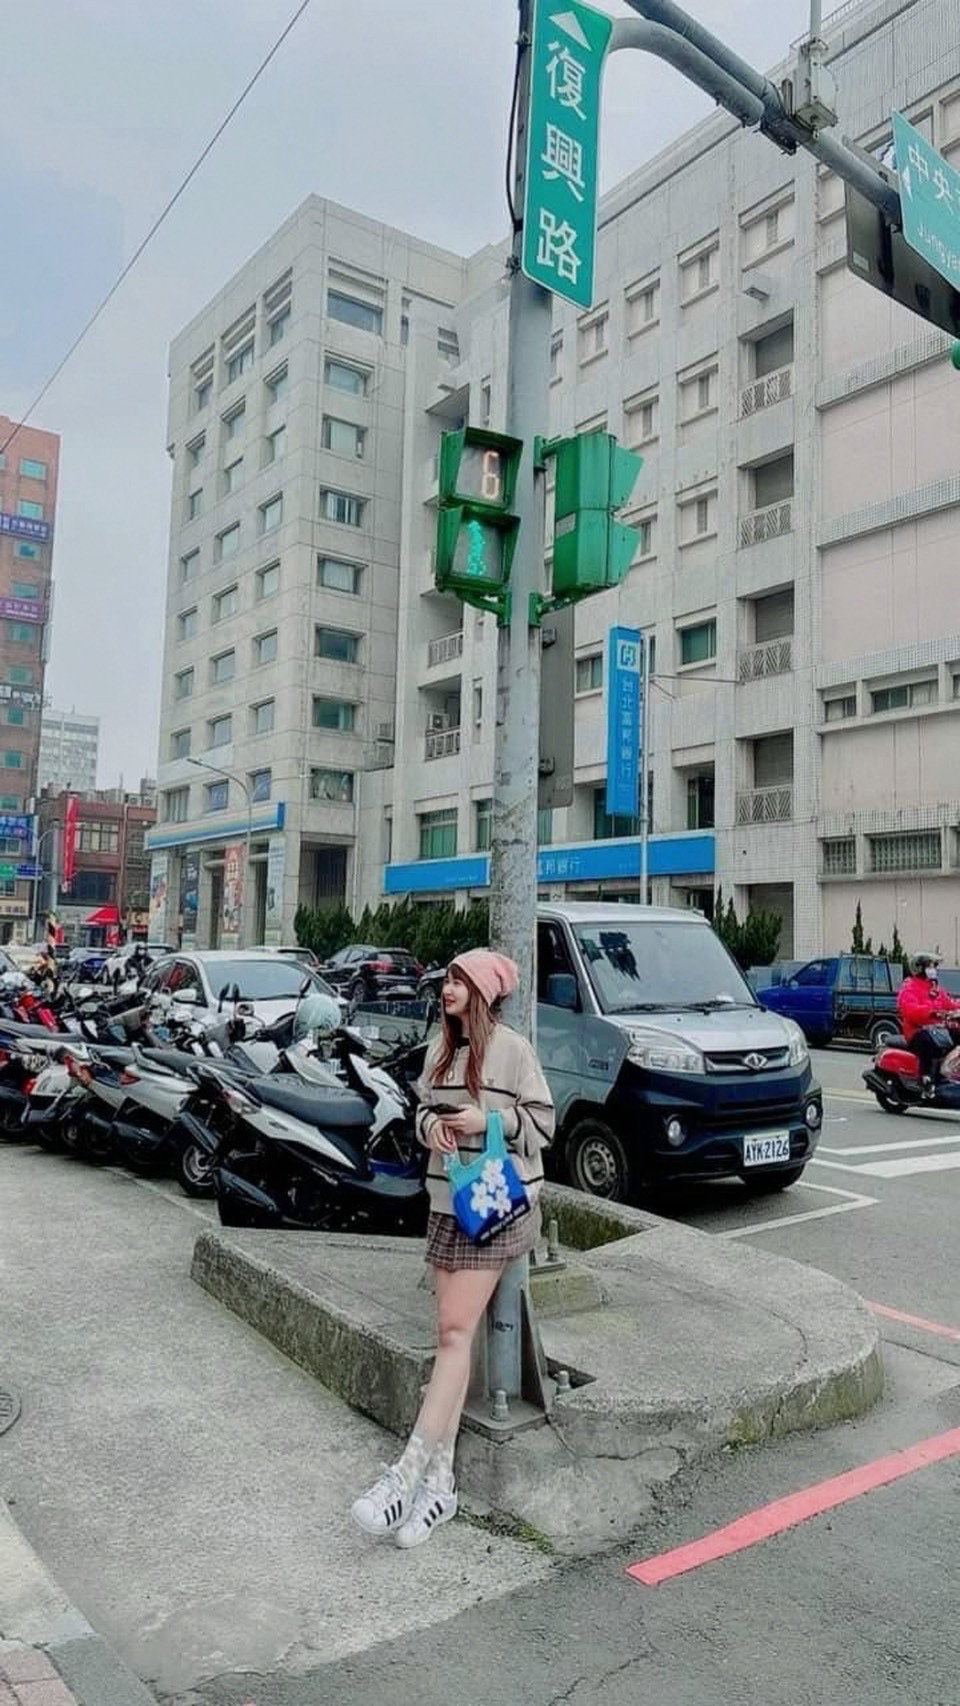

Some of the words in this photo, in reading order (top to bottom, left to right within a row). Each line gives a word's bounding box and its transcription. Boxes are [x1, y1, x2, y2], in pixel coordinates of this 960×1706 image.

[536, 40, 587, 285] 復興路
[908, 143, 960, 217] 中央
[917, 216, 960, 271] Jungya
[482, 449, 500, 499] 6
[744, 1140, 789, 1162] AYK-2126
